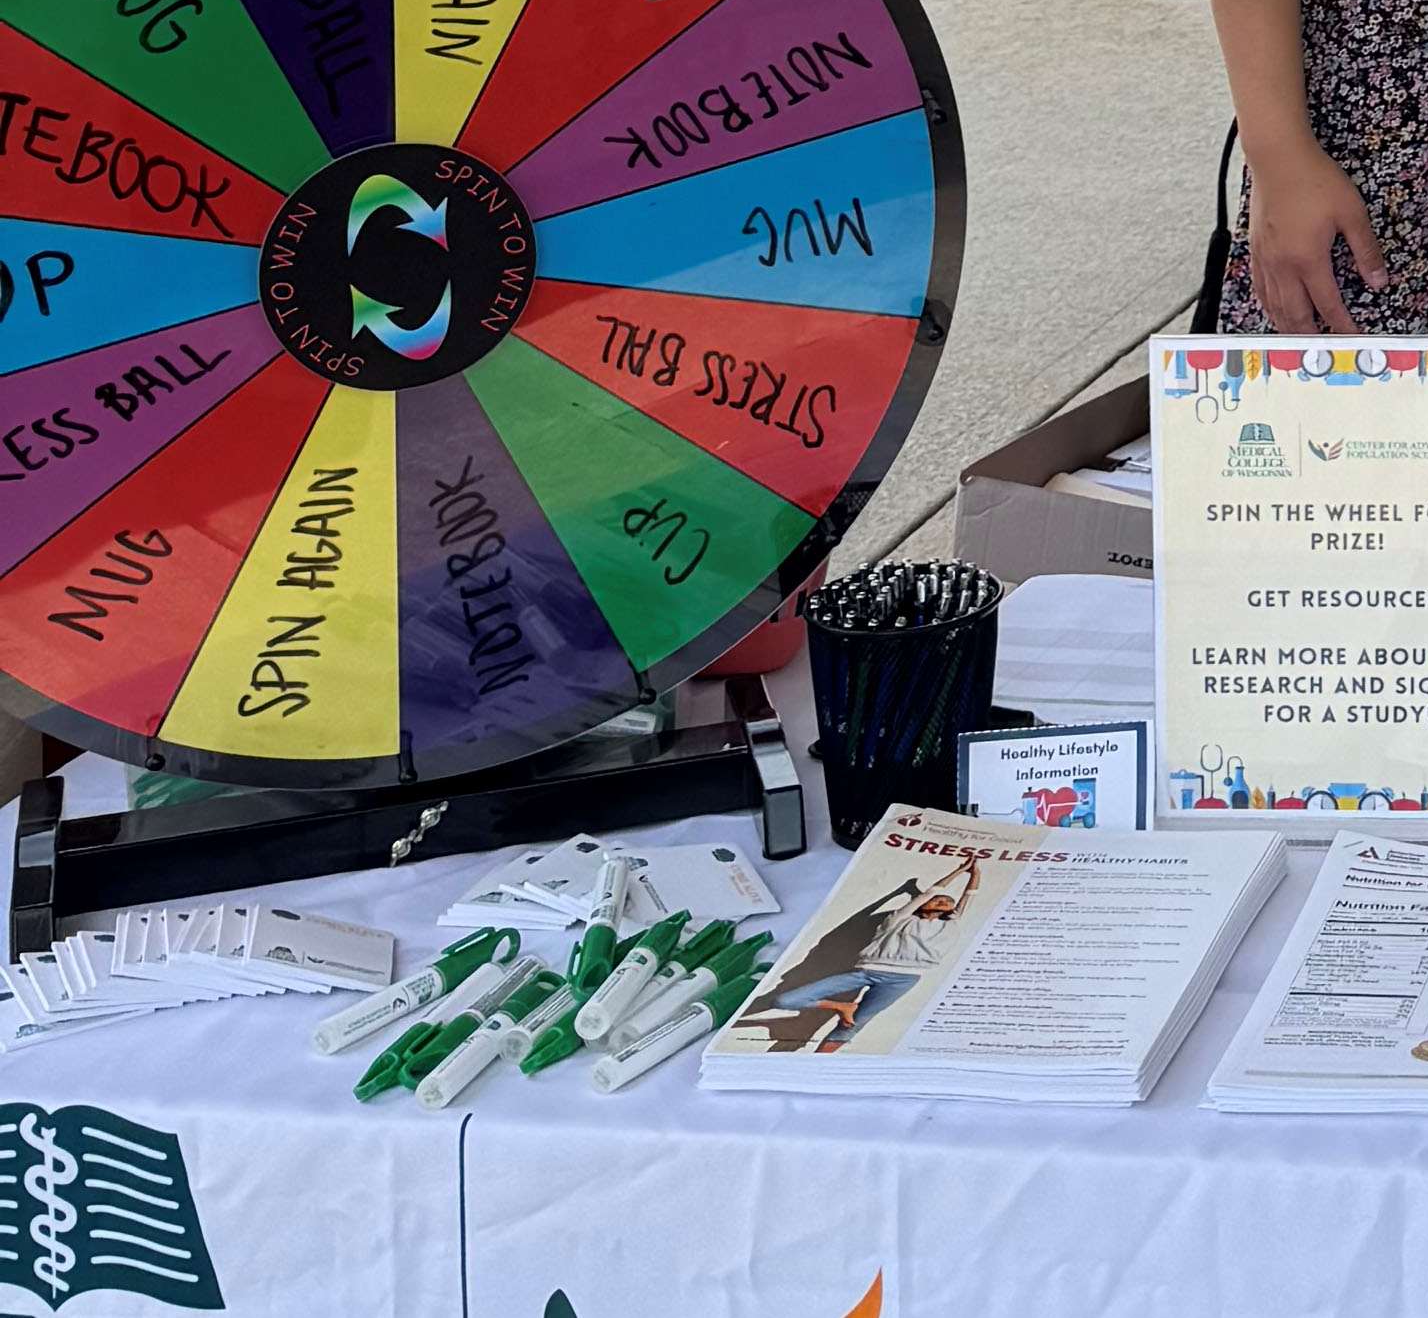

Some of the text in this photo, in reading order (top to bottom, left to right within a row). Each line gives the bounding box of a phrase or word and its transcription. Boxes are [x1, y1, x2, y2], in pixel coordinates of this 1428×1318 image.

[603, 32, 873, 169] NOTEBOOK
[435, 160, 527, 331] SPIN TO WIN
[742, 197, 873, 266] MUG
[270, 202, 365, 376] SPIN TO WIN
[94, 344, 231, 422] BALL
[596, 314, 836, 448] STRESS BALL
[1207, 504, 1261, 523] SPIN
[1271, 504, 1318, 523] THE
[1326, 504, 1404, 523] WHEEL
[623, 498, 710, 585] CUP
[1311, 532, 1385, 551] PRIZE!
[47, 526, 173, 643] MUG
[238, 467, 359, 718] SPIN AGAIN
[428, 455, 536, 697] NOTEBOOK
[1247, 589, 1292, 608] GET
[1193, 647, 1268, 666] LEARN
[1278, 647, 1350, 666] MORE
[1204, 675, 1328, 695] RESEARCH
[1335, 676, 1386, 695] AND
[1264, 704, 1315, 723] FOR
[1323, 704, 1338, 723] A
[1001, 741, 1119, 763] Healthy Lifestyle
[1016, 763, 1099, 781] Information
[885, 833, 994, 860] STRESS
[998, 850, 1070, 863] LESS
[1336, 900, 1406, 912] Nutrition
